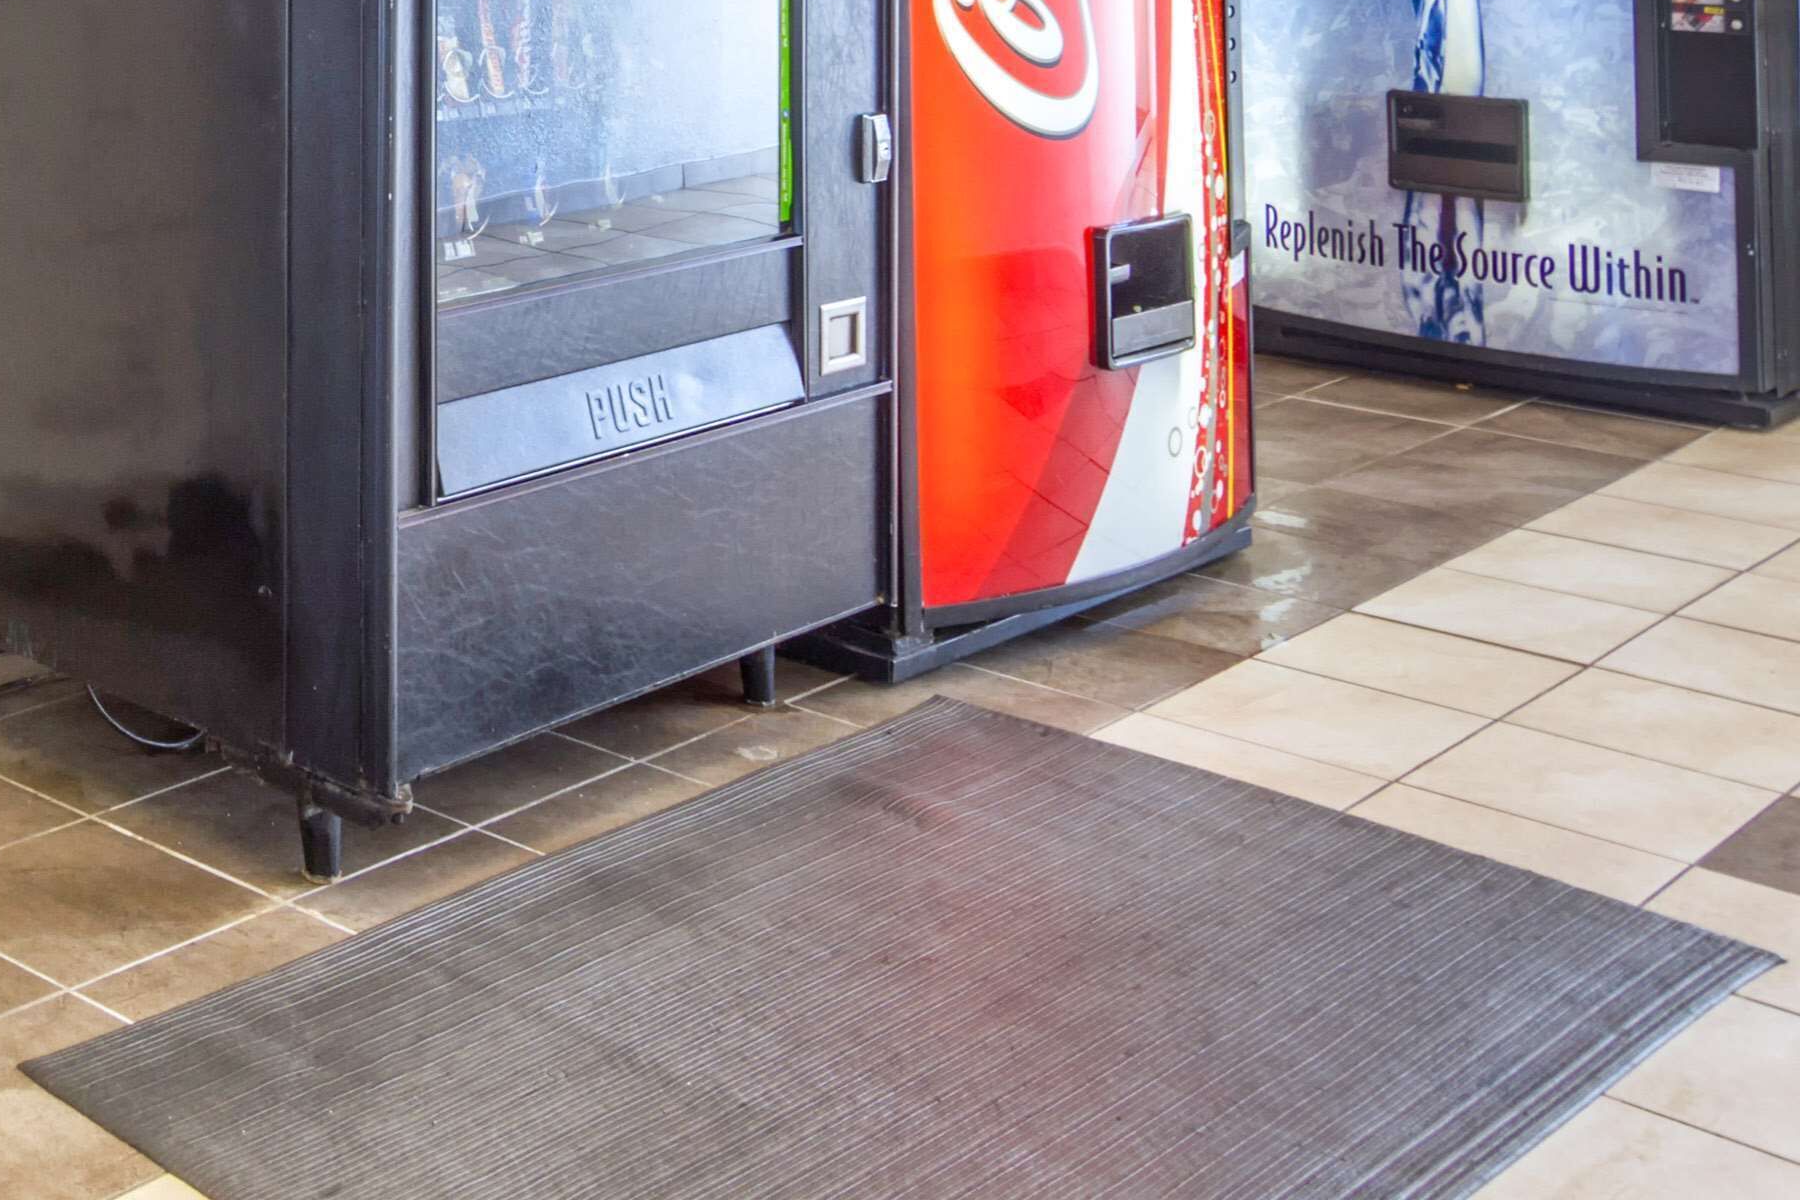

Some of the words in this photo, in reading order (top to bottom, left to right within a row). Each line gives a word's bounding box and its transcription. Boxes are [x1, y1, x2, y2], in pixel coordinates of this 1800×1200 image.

[1265, 203, 1385, 267] Replenish
[1392, 222, 1443, 276] The
[1456, 231, 1555, 289] Source
[1568, 243, 1686, 304] Within
[585, 374, 674, 440] PUSH
